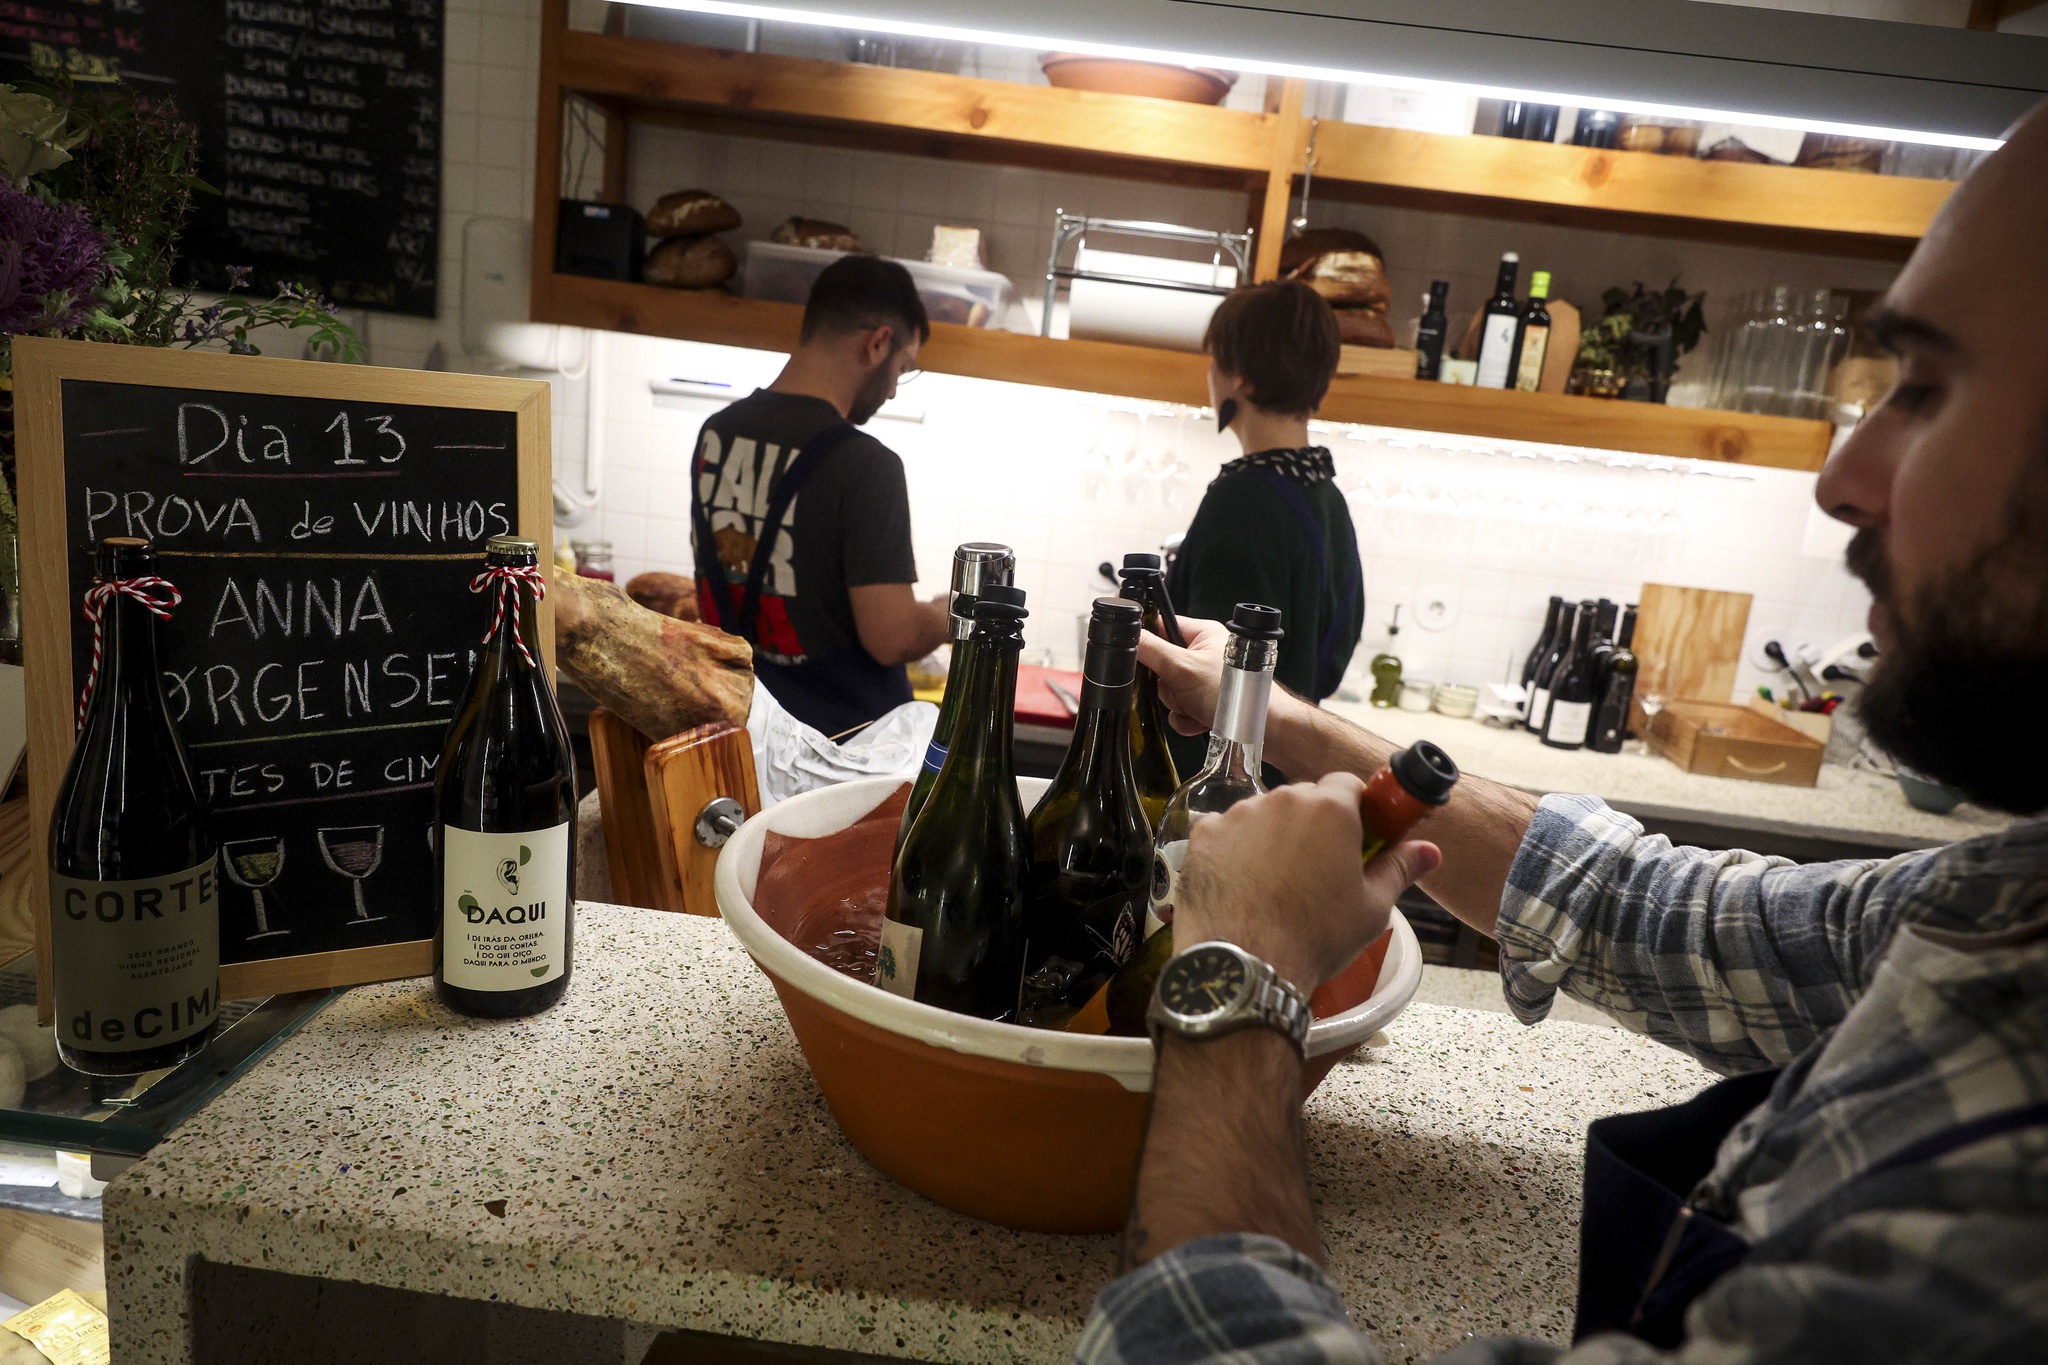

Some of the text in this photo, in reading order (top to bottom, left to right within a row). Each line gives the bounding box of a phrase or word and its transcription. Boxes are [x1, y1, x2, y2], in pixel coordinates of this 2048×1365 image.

[177, 402, 407, 466] Dia 13
[85, 486, 510, 544] PROVA de VINHOS
[209, 576, 394, 641] ANNA
[199, 754, 441, 804] TES DE CIM
[467, 901, 546, 925] DAQUI
[118, 947, 202, 971] VINHO REGIONAL
[128, 939, 195, 960] 2021 BRANCO
[130, 959, 194, 980] ALENTEJANO
[463, 958, 487, 967] DAQUI
[489, 959, 510, 967] PARA
